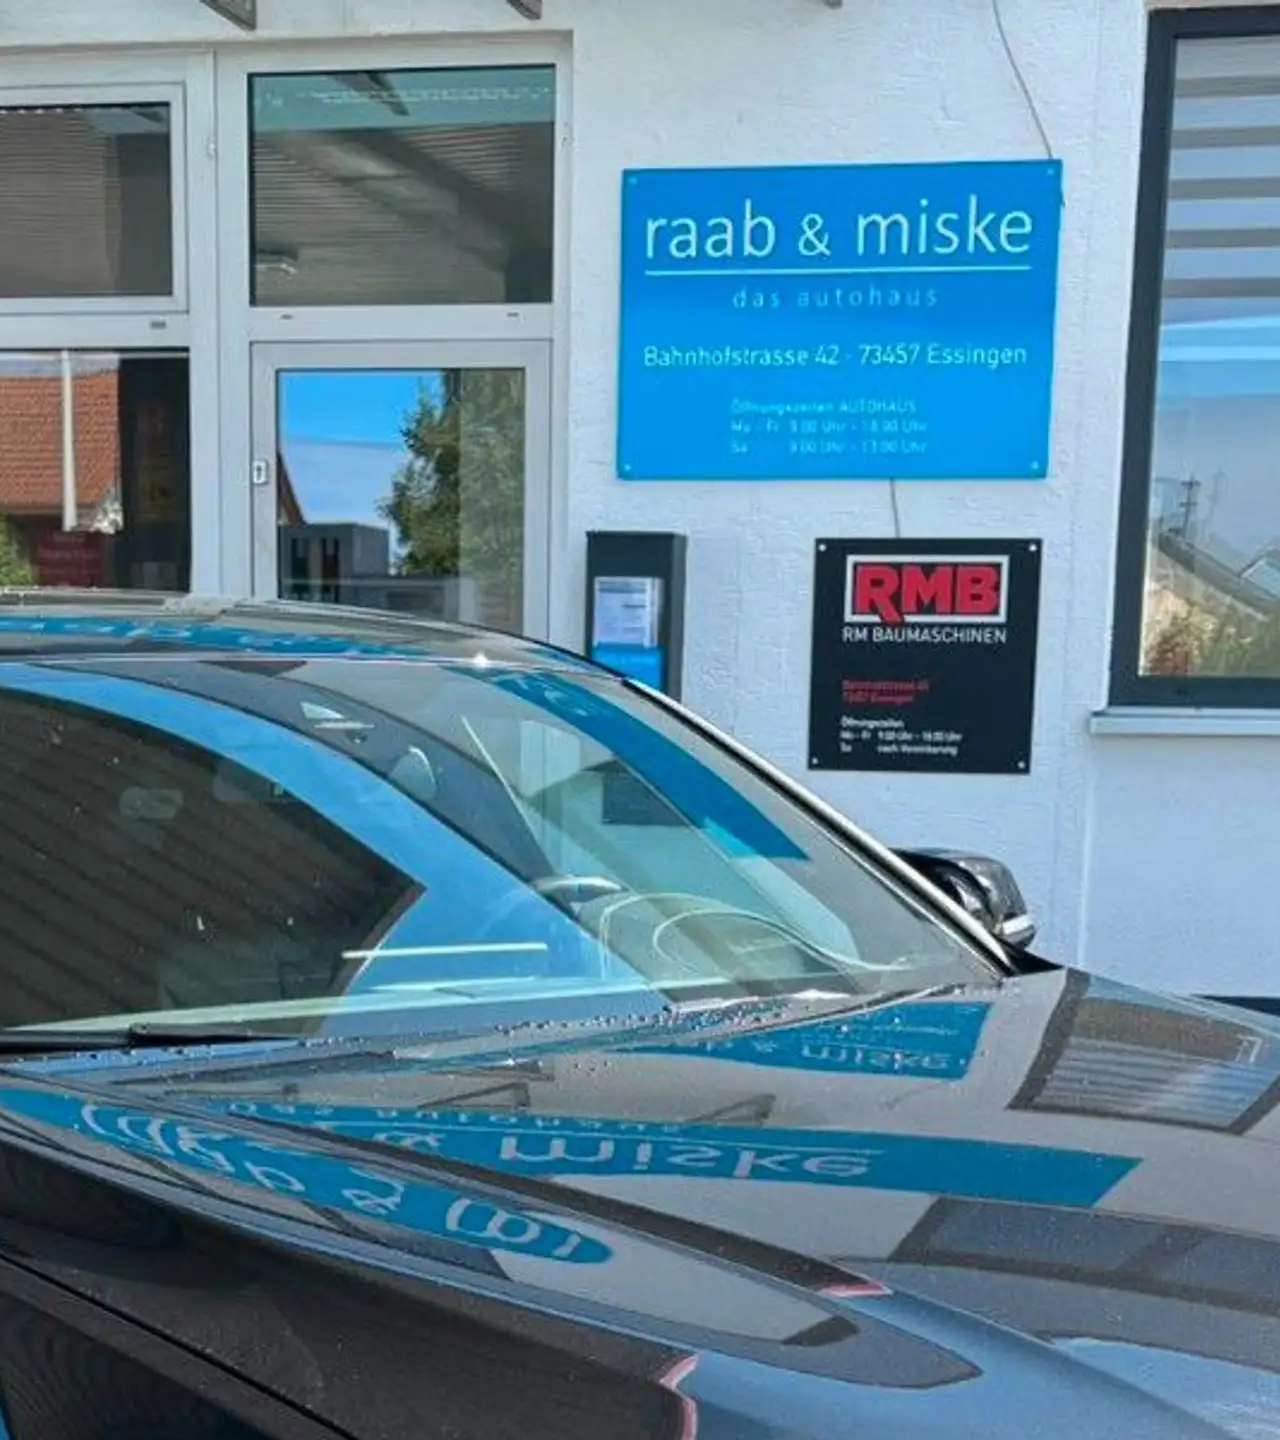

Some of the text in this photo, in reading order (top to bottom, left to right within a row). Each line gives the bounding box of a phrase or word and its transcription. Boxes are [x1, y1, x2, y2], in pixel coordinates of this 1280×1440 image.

[646, 194, 1033, 259] raab & miske
[732, 286, 939, 309] das autohaus
[643, 345, 810, 368] Bahnhofstrasse
[814, 345, 840, 365] 42
[859, 344, 920, 365] 73457
[927, 343, 1028, 370] Essingen
[855, 563, 998, 625] RMB
[842, 626, 1007, 644] RM BAUMASCHINEN
